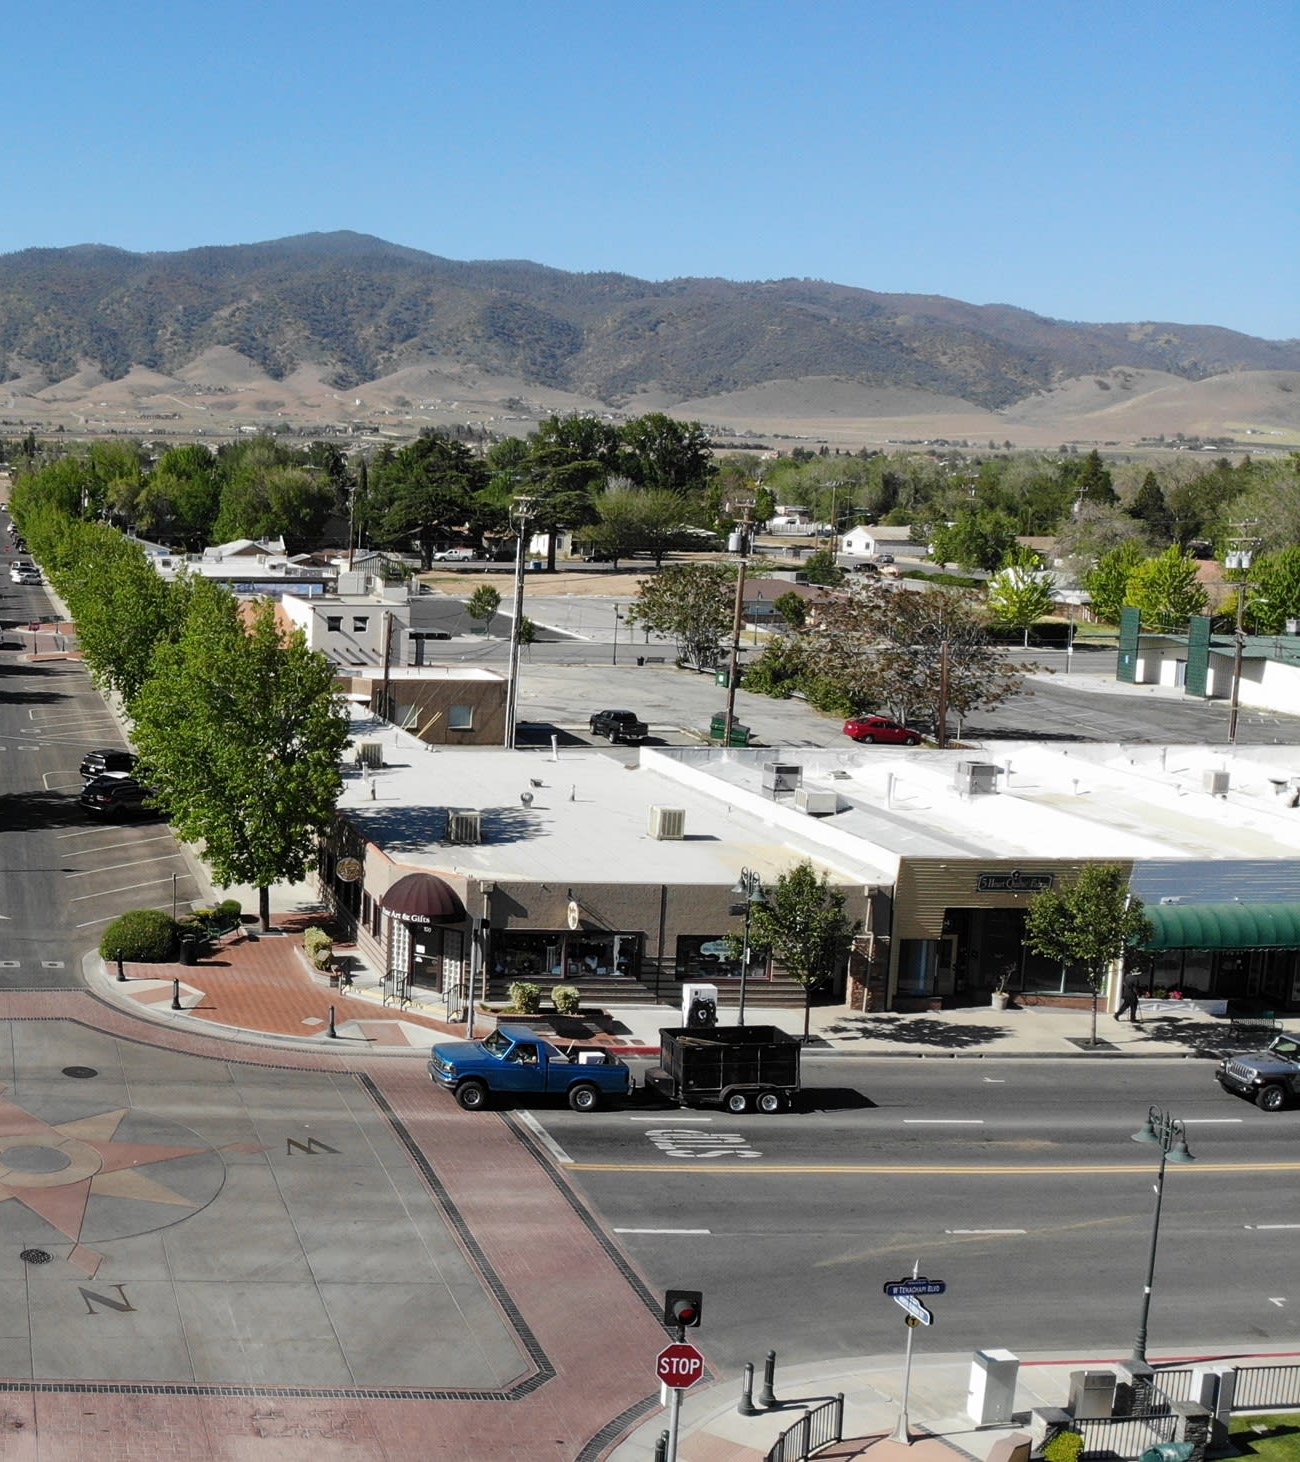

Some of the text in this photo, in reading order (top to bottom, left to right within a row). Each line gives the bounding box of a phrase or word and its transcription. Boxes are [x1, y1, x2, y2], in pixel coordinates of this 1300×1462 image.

[391, 909, 401, 919] Art
[411, 914, 430, 923] Gifts
[644, 1129, 763, 1158] STOP
[77, 1283, 138, 1315] N
[660, 1357, 700, 1375] STOP
